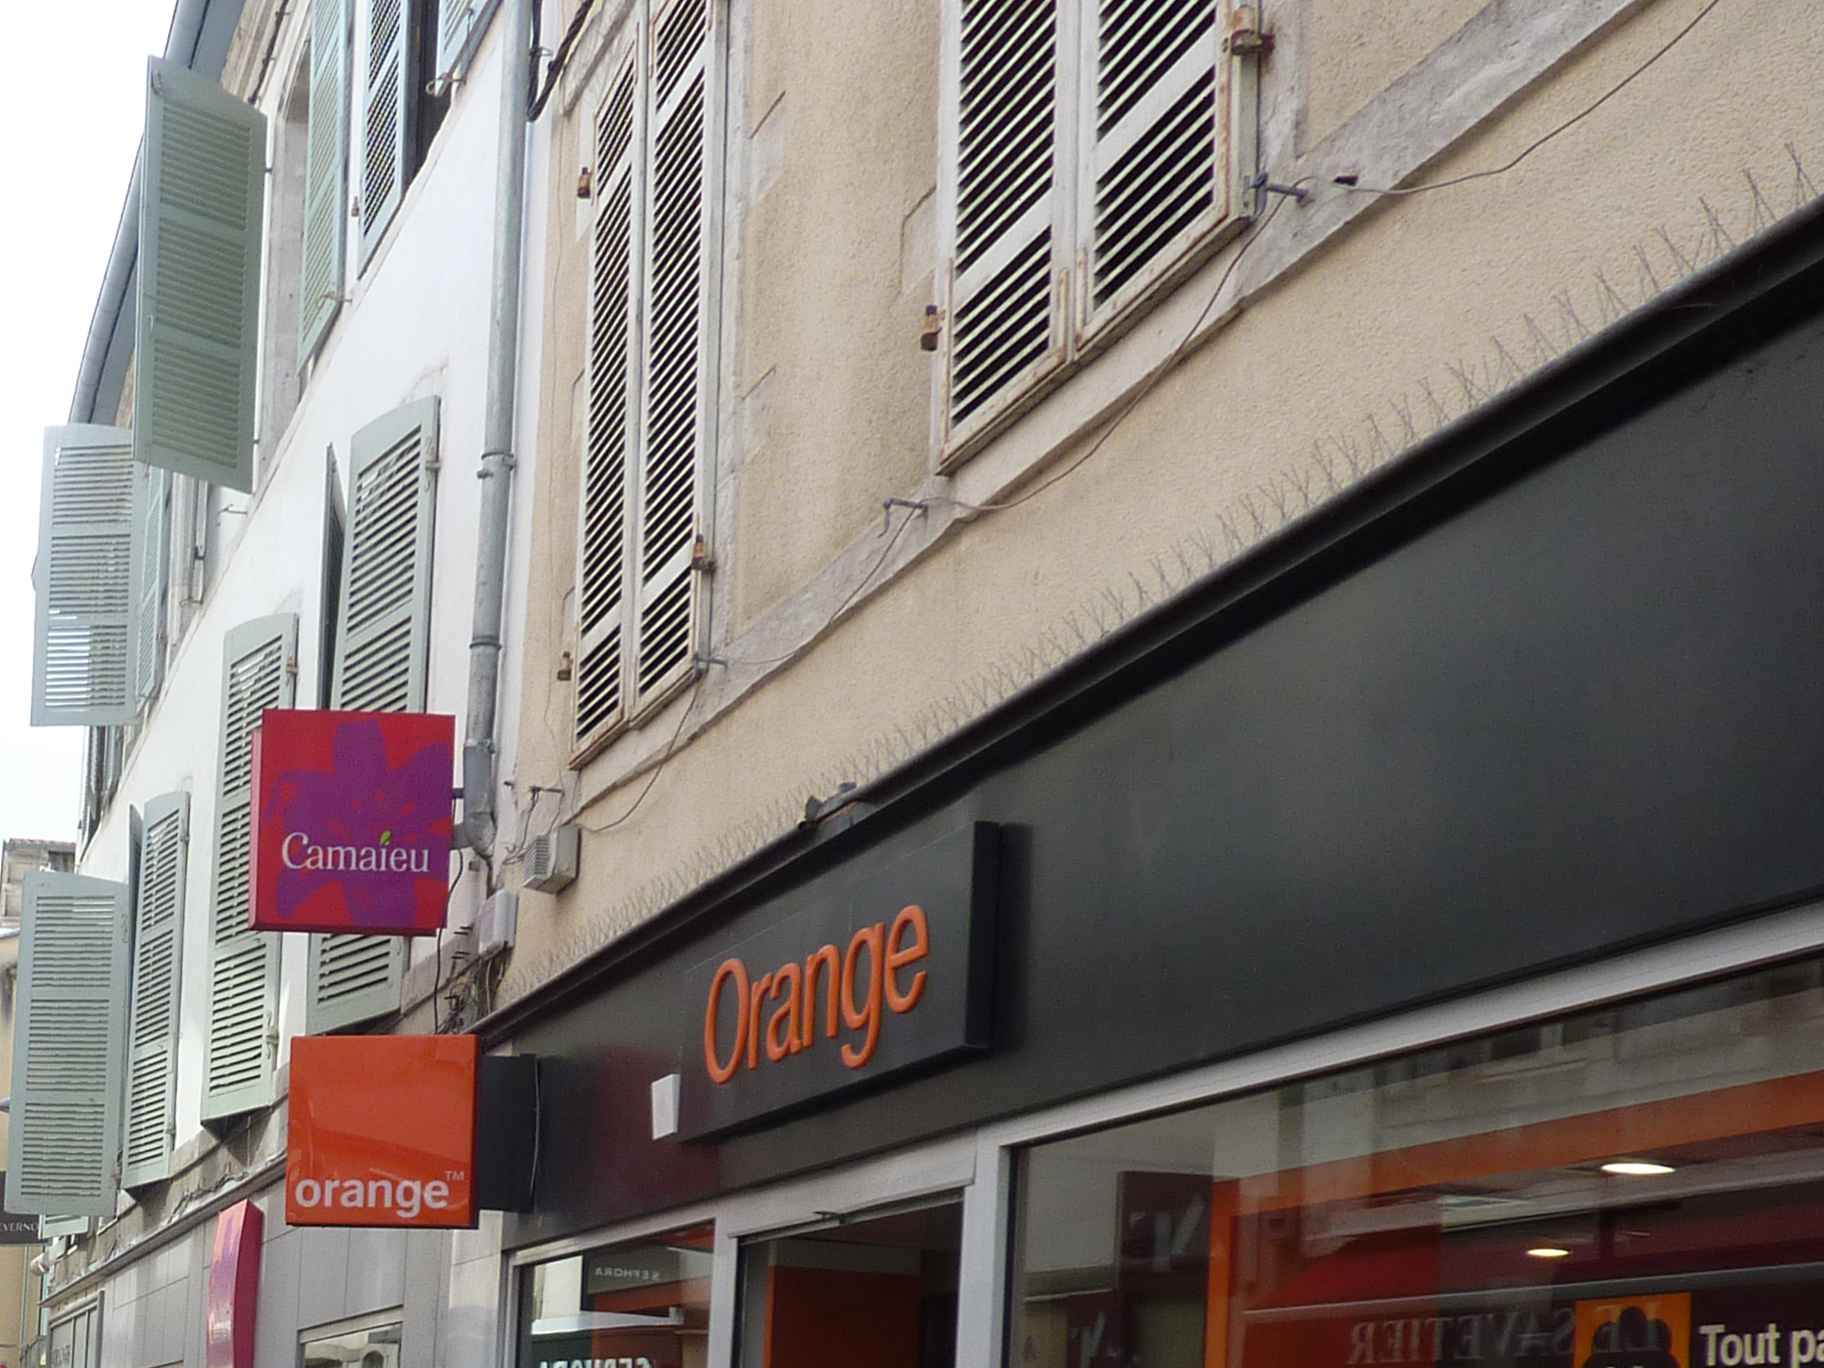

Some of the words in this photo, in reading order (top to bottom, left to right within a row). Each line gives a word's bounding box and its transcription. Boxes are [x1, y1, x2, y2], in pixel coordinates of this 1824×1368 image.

[704, 905, 929, 1084] Orange
[294, 1177, 450, 1218] orange
[1699, 1323, 1781, 1367] Tout
